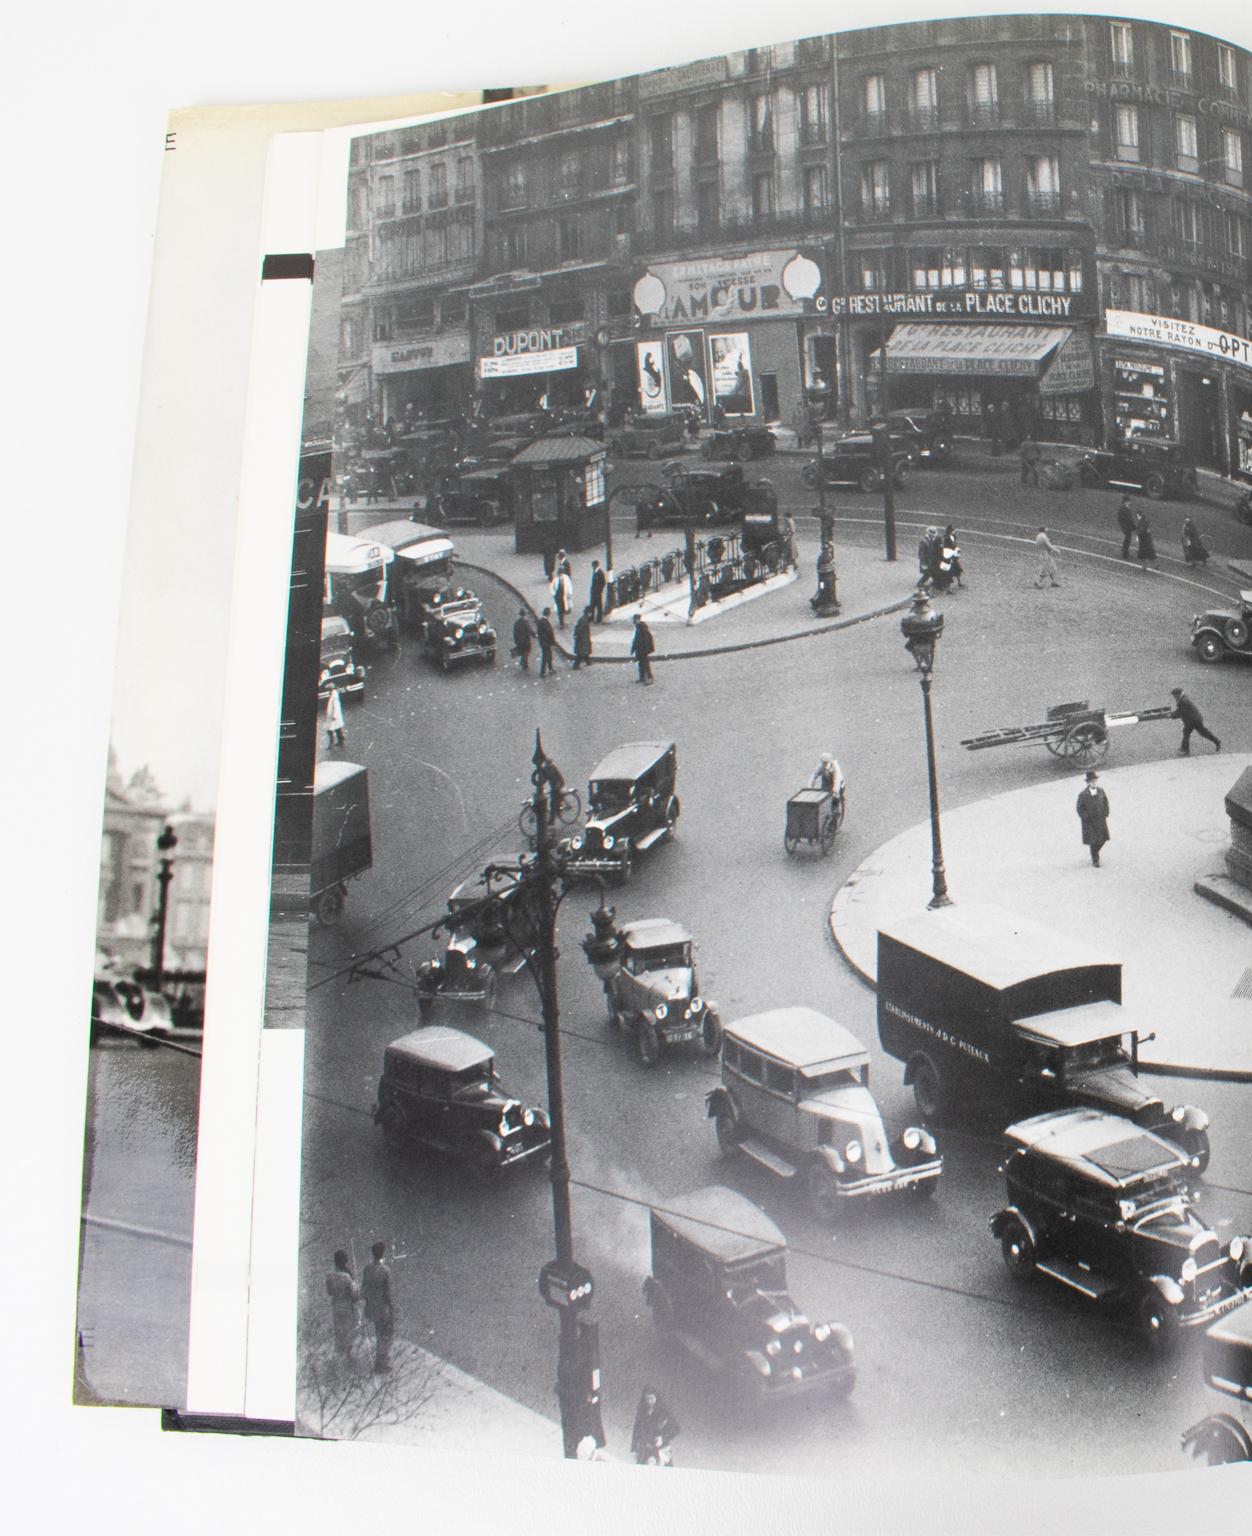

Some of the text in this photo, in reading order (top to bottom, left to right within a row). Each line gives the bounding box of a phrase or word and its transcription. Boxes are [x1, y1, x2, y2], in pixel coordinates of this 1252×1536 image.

[849, 293, 934, 315] RESTAURANT
[965, 292, 1016, 314] PLACE
[1017, 293, 1073, 317] CLICHY
[1129, 325, 1163, 339] NOTRE
[1167, 331, 1201, 350] RAYON
[1150, 317, 1196, 336] VISITEZ
[493, 329, 564, 356] DUPONT
[934, 341, 981, 353] PLACE
[984, 342, 1044, 354] CLICHY
